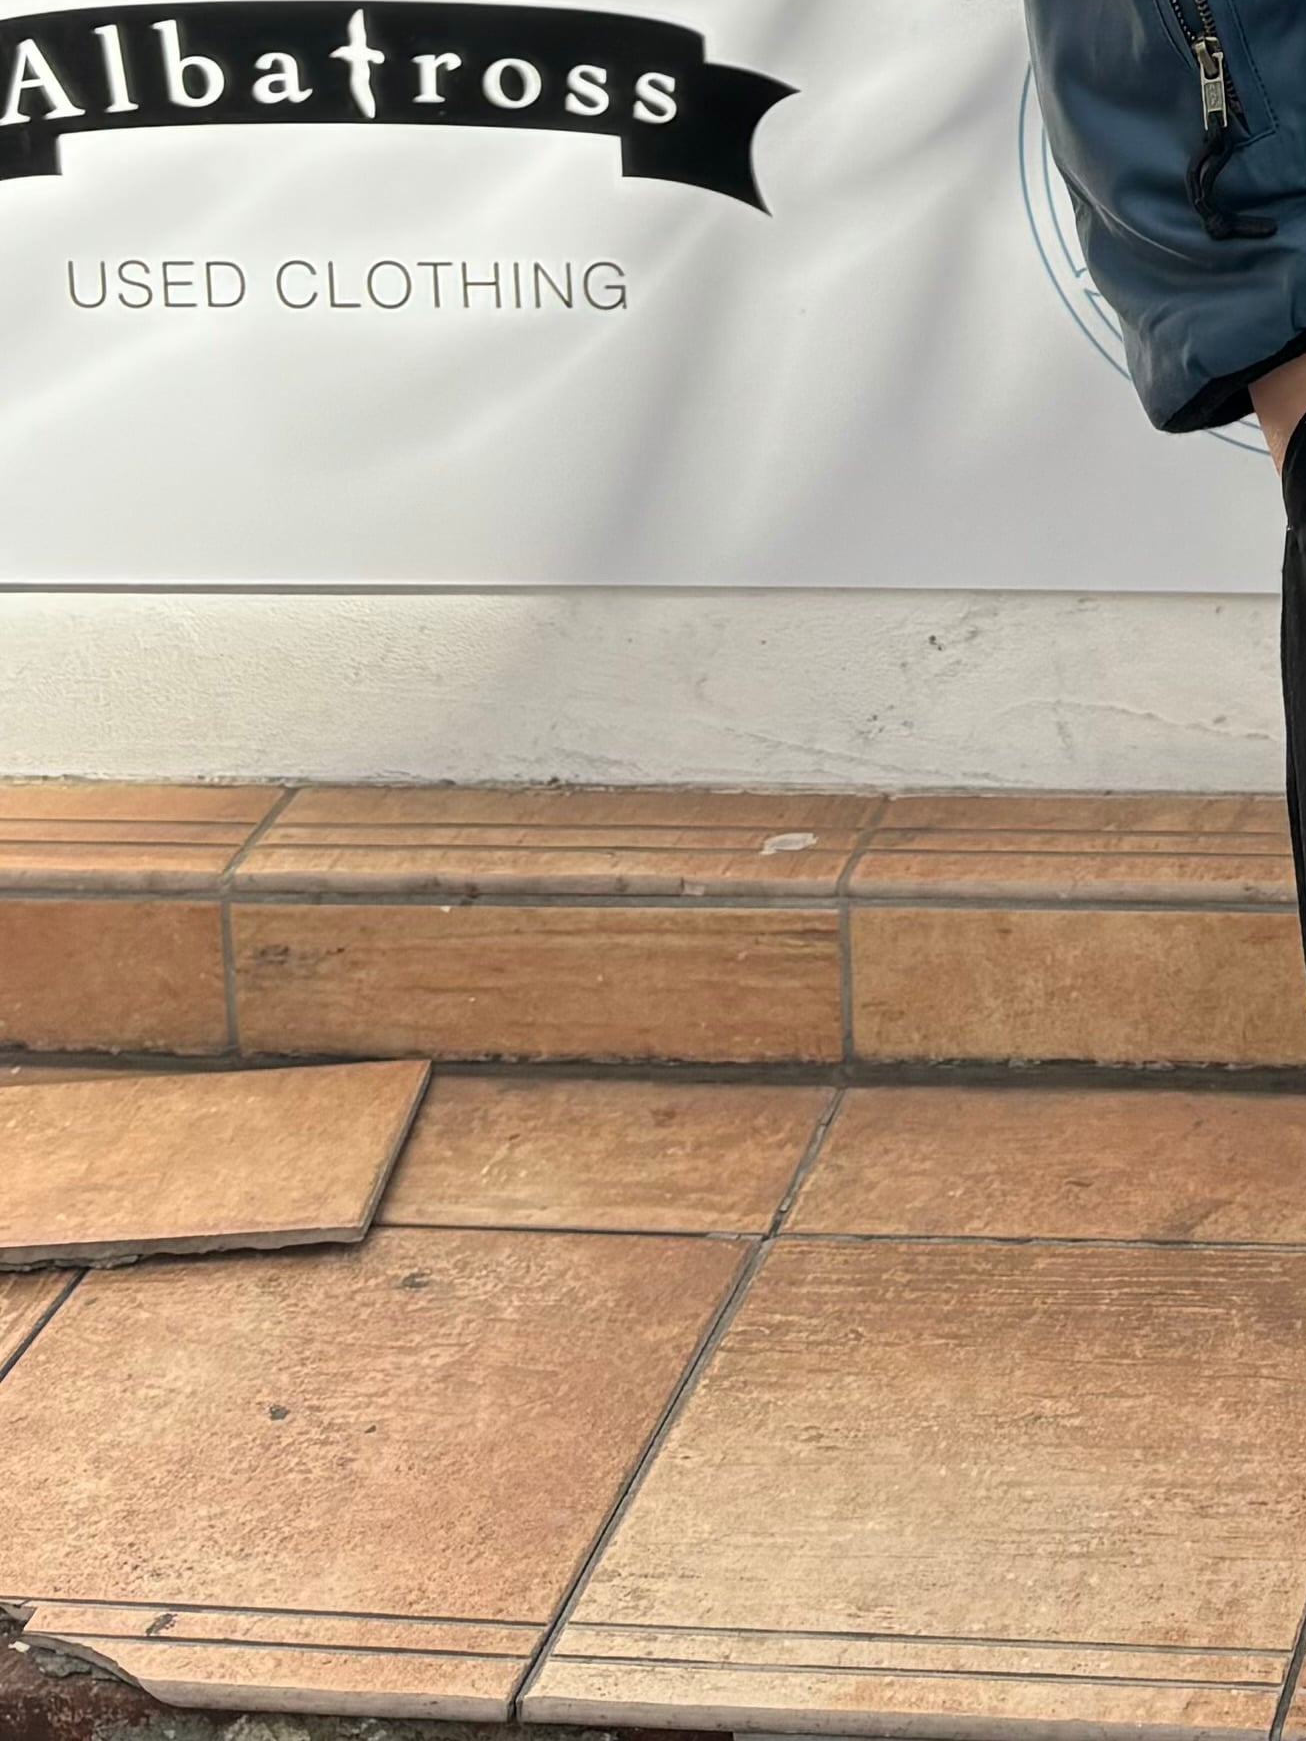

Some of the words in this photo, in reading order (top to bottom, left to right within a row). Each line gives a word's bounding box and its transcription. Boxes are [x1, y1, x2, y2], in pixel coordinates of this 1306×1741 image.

[0, 8, 678, 126] Albatross
[68, 260, 246, 310] USED
[276, 260, 628, 312] CLOTHING
